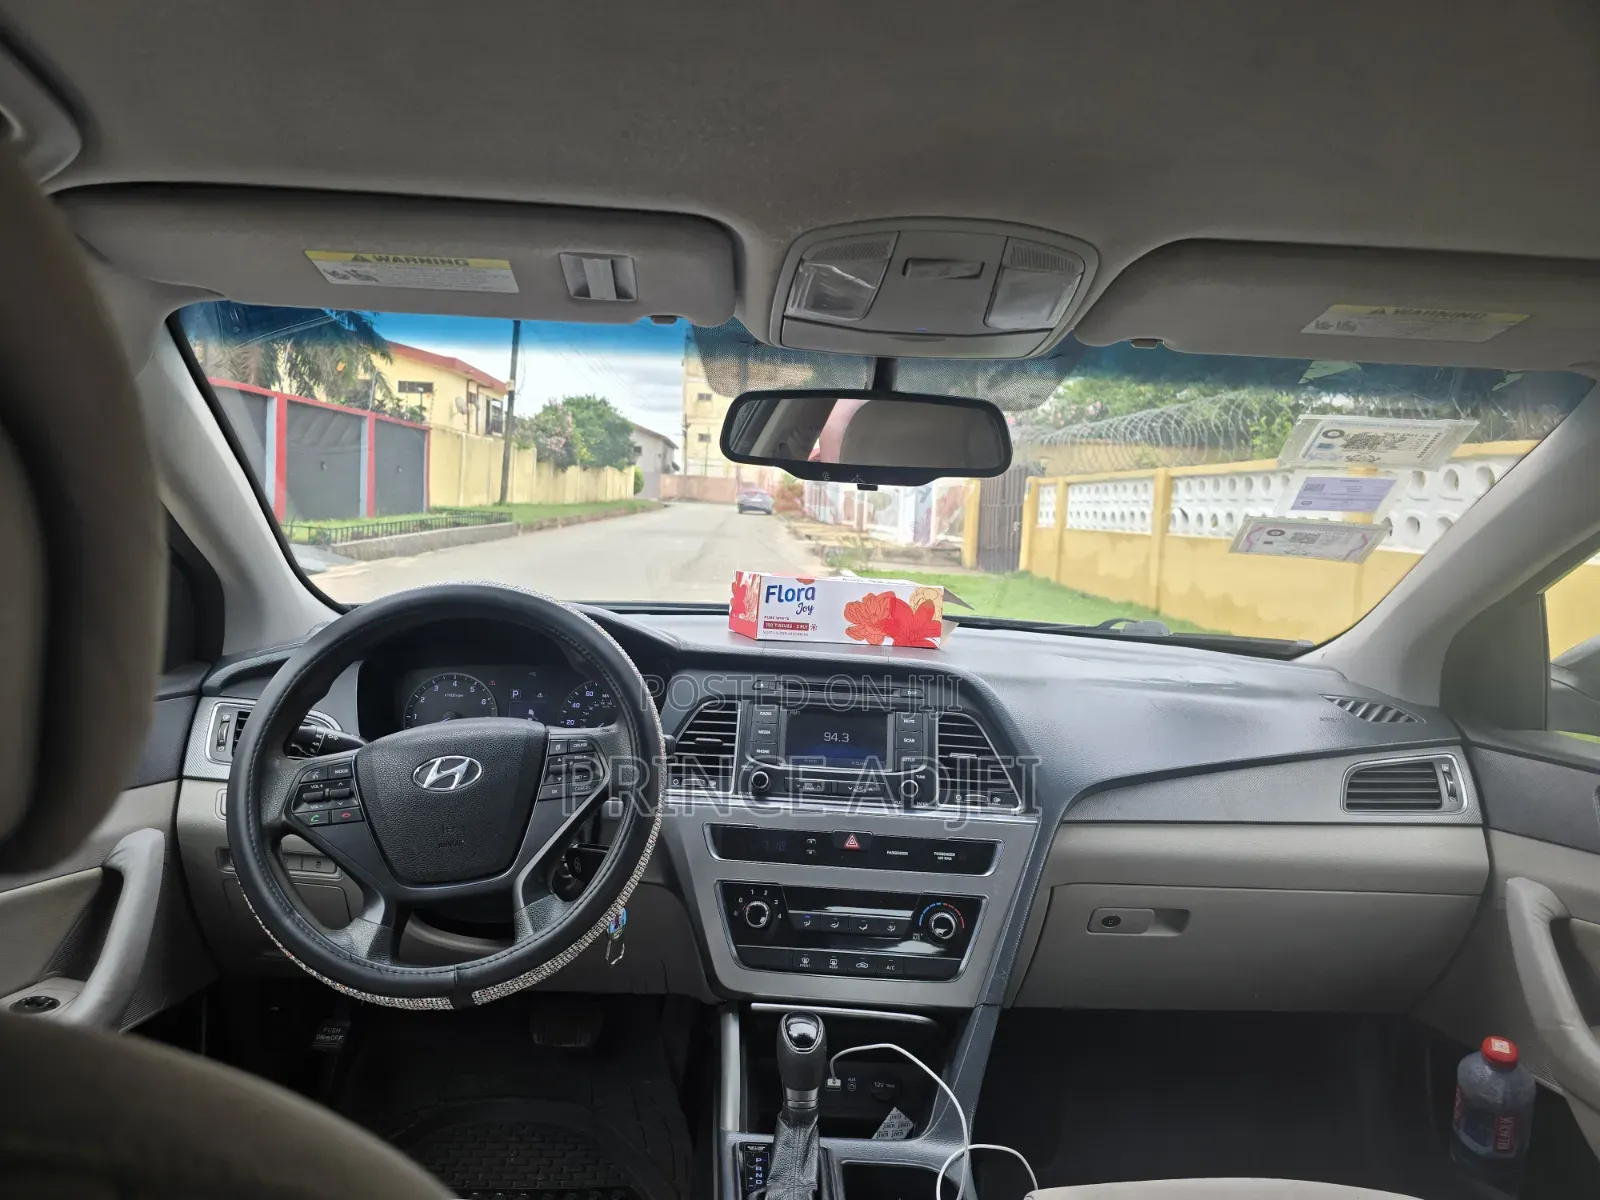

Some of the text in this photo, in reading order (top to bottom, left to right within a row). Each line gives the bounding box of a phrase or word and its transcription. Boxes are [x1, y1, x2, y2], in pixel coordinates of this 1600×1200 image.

[371, 254, 470, 267] WARNING
[1392, 308, 1488, 320] WARNING
[765, 585, 815, 603] Flora
[796, 602, 814, 615] Joy
[512, 690, 519, 698] P
[823, 731, 850, 743] 94.3
